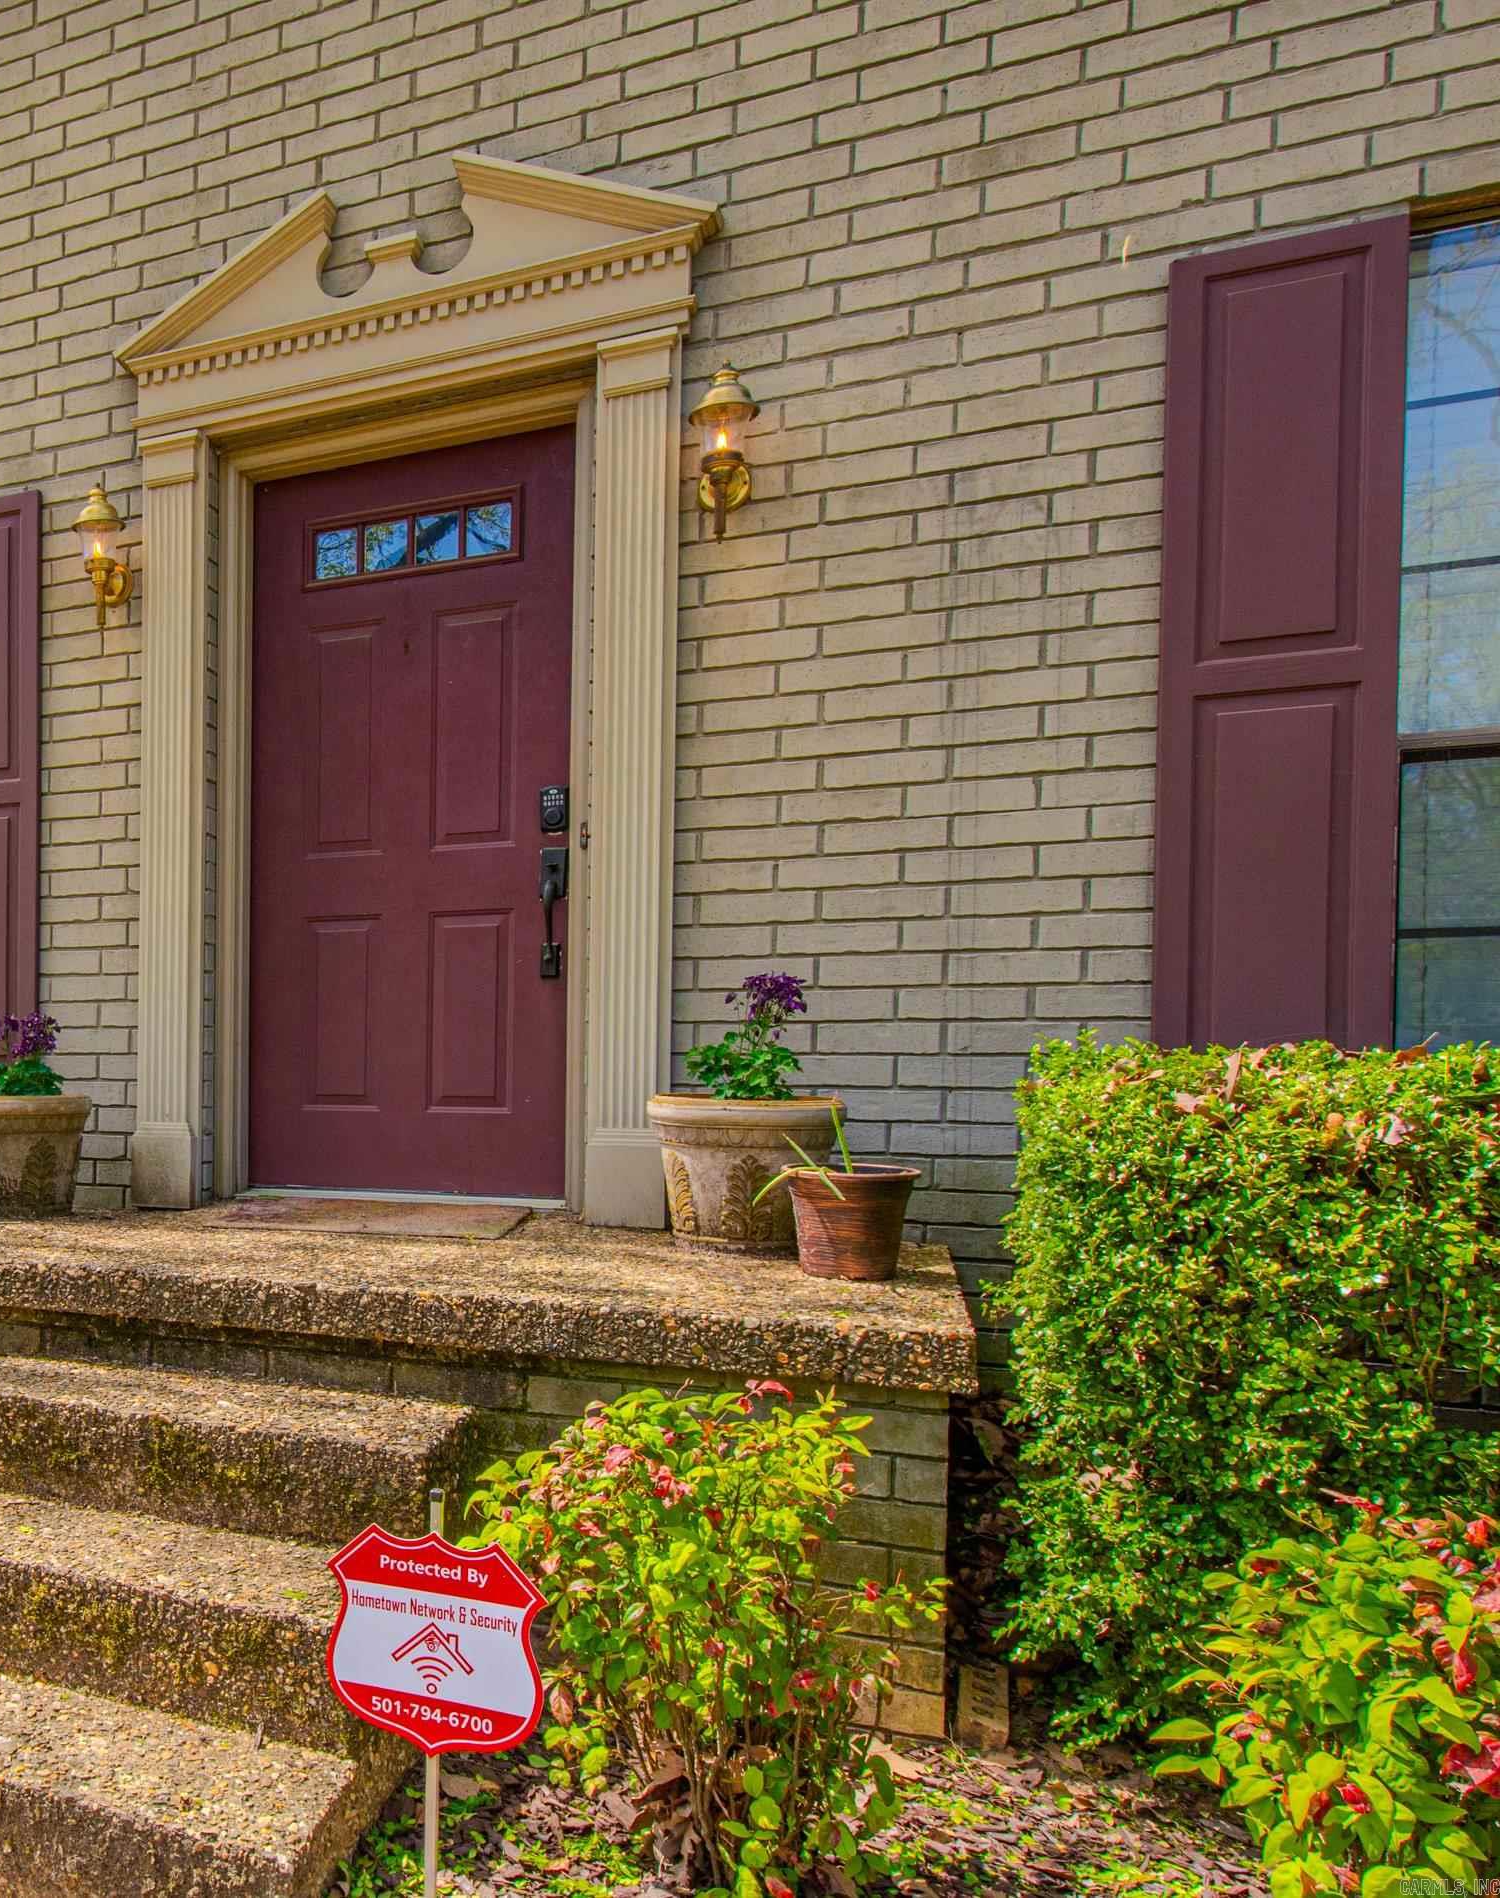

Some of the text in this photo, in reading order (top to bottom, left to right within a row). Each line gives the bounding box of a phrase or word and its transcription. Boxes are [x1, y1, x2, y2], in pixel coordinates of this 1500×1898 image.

[379, 1554, 489, 1588] Protected By
[351, 1588, 518, 1637] Hometown Network & Security
[371, 1695, 493, 1735] 501-794-6700
